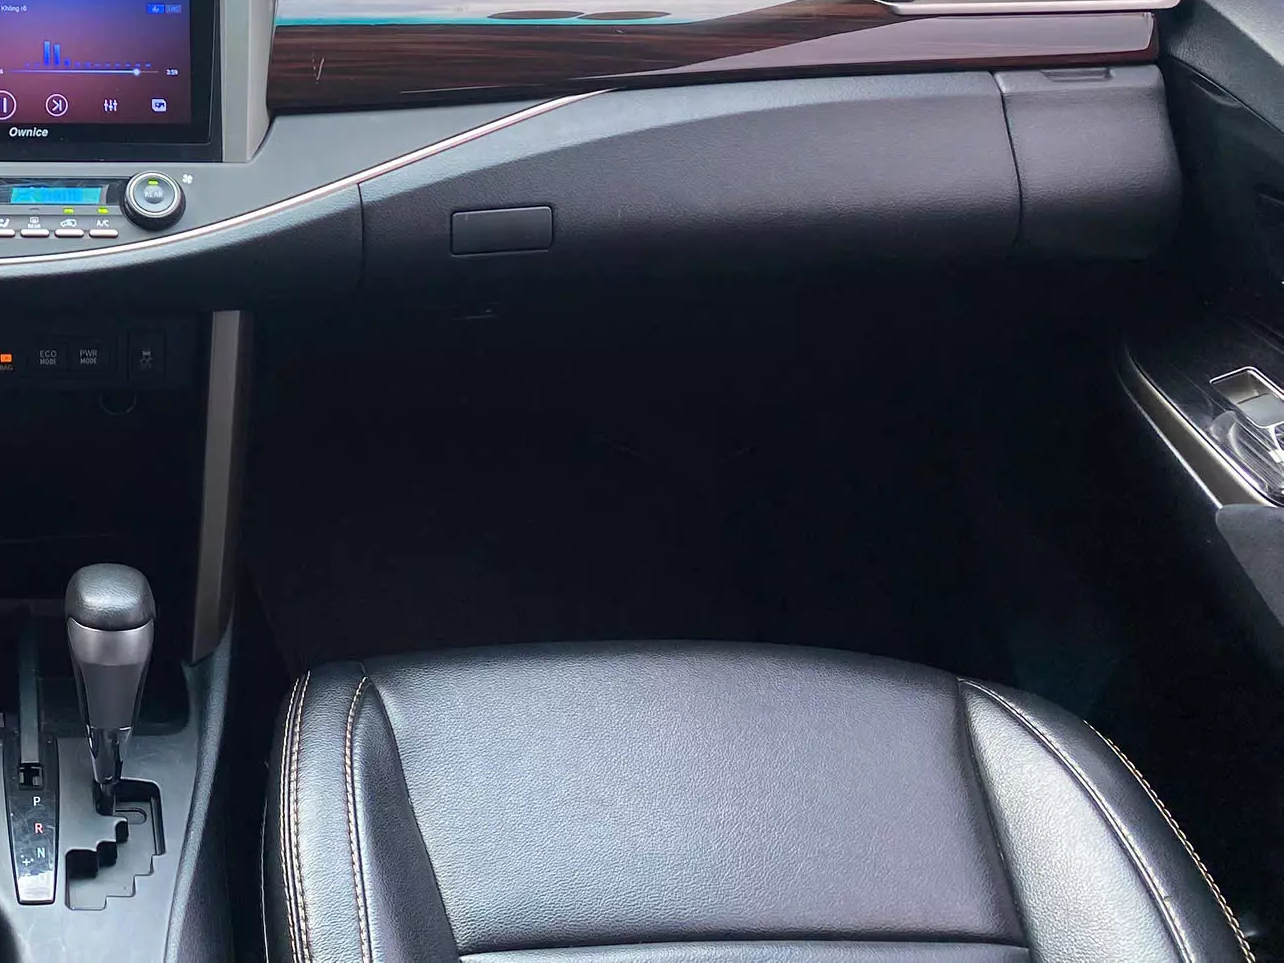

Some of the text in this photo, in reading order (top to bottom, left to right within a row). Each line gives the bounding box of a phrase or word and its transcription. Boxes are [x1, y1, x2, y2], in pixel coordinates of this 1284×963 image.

[9, 127, 49, 138] Ownice
[144, 190, 163, 198] REAR
[80, 349, 98, 357] PWR
[80, 357, 97, 365] MODE
[33, 796, 41, 806] P
[34, 823, 43, 834] R
[37, 847, 46, 858] N
